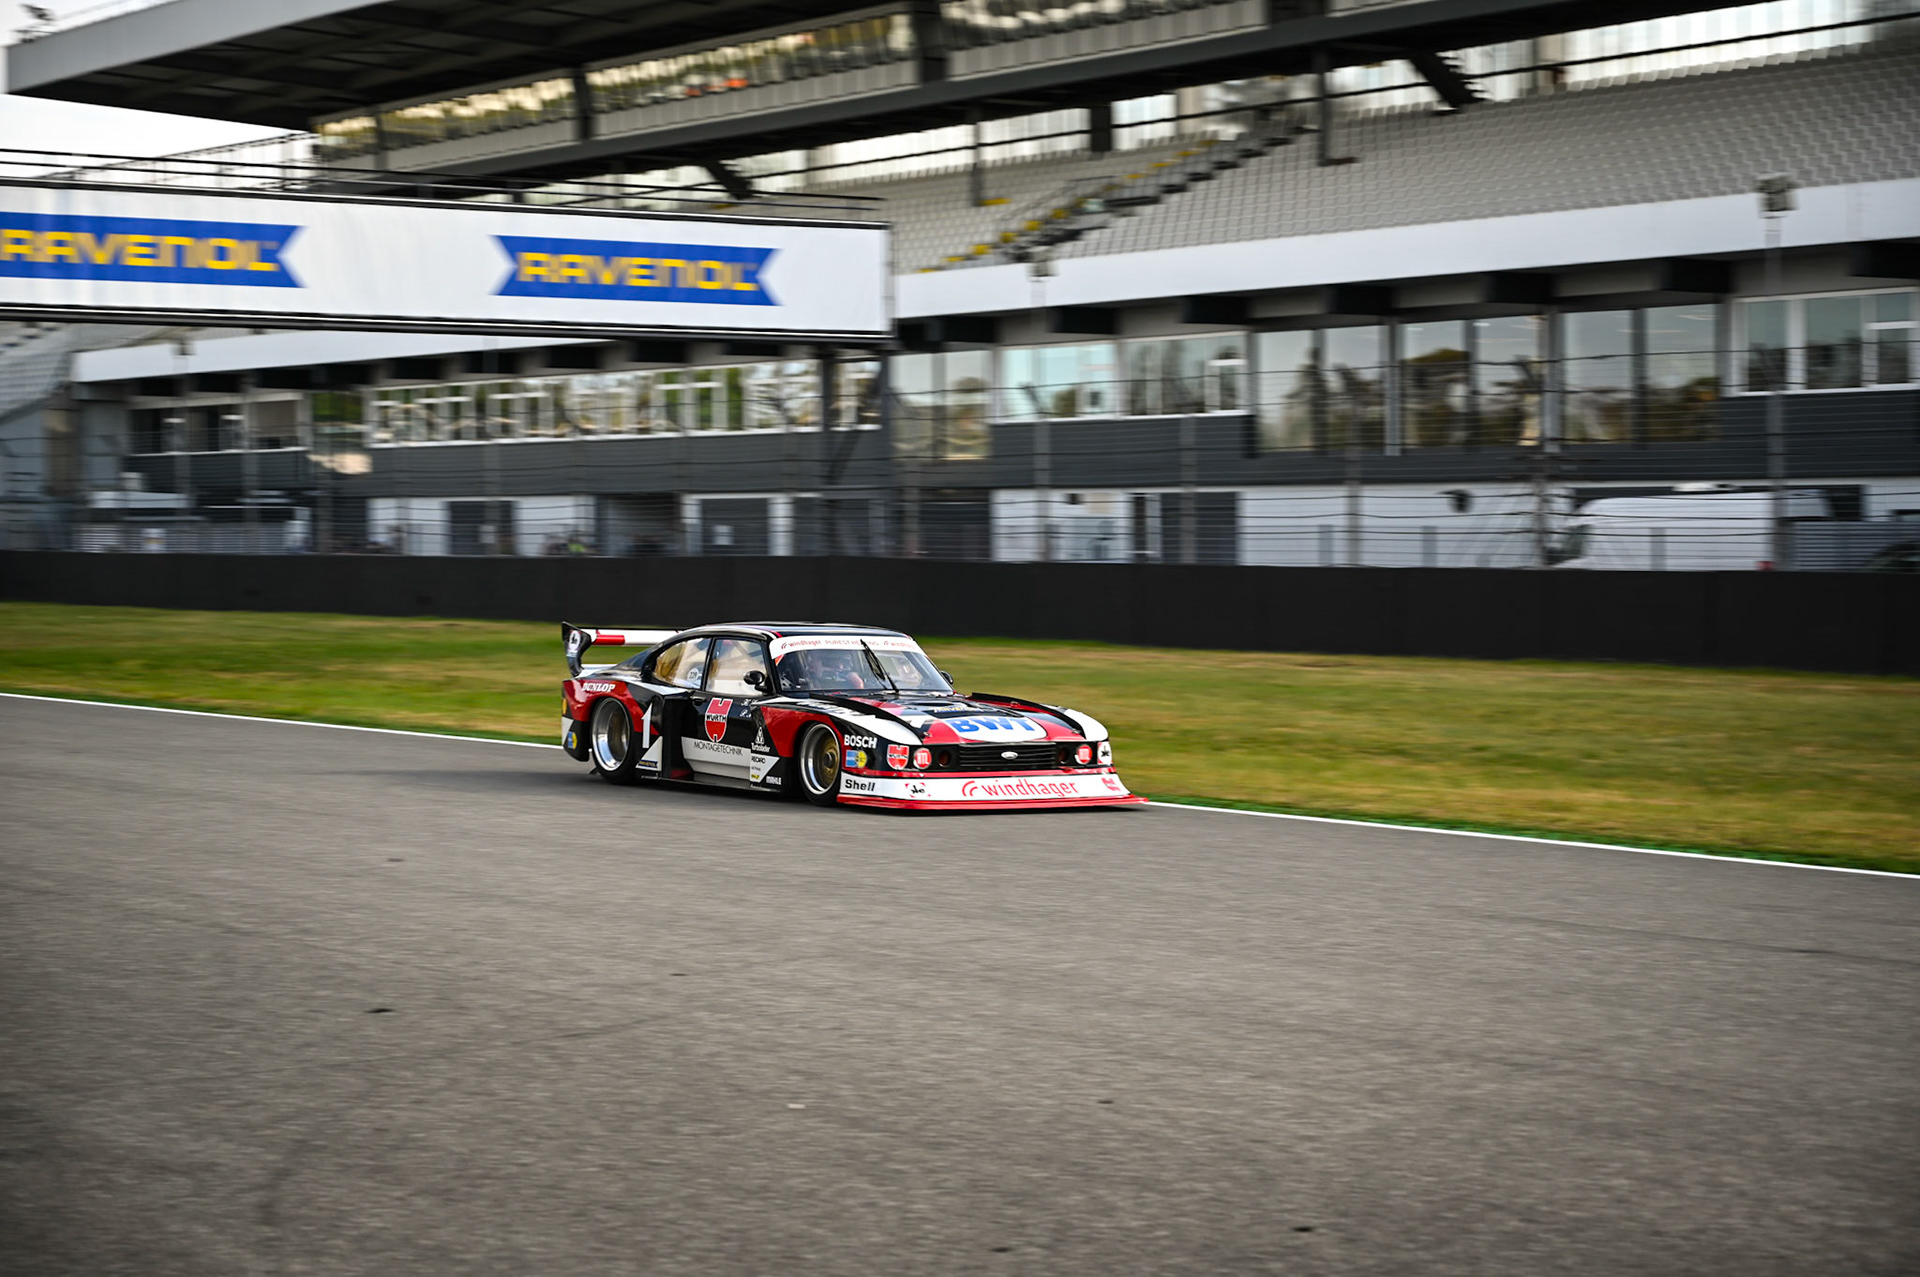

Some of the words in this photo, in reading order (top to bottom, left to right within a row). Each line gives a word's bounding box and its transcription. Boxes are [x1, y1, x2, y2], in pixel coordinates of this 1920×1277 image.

[0, 228, 279, 272] RAVENOL
[516, 252, 760, 291] RAVENOL
[581, 682, 616, 692] DUNLOP
[641, 702, 653, 749] 1
[945, 717, 1035, 733] BWT
[693, 741, 743, 757] MONTAGETECHNIK
[843, 734, 878, 749] BOSCH
[845, 779, 876, 792] Shell
[981, 778, 1079, 797] windhager
